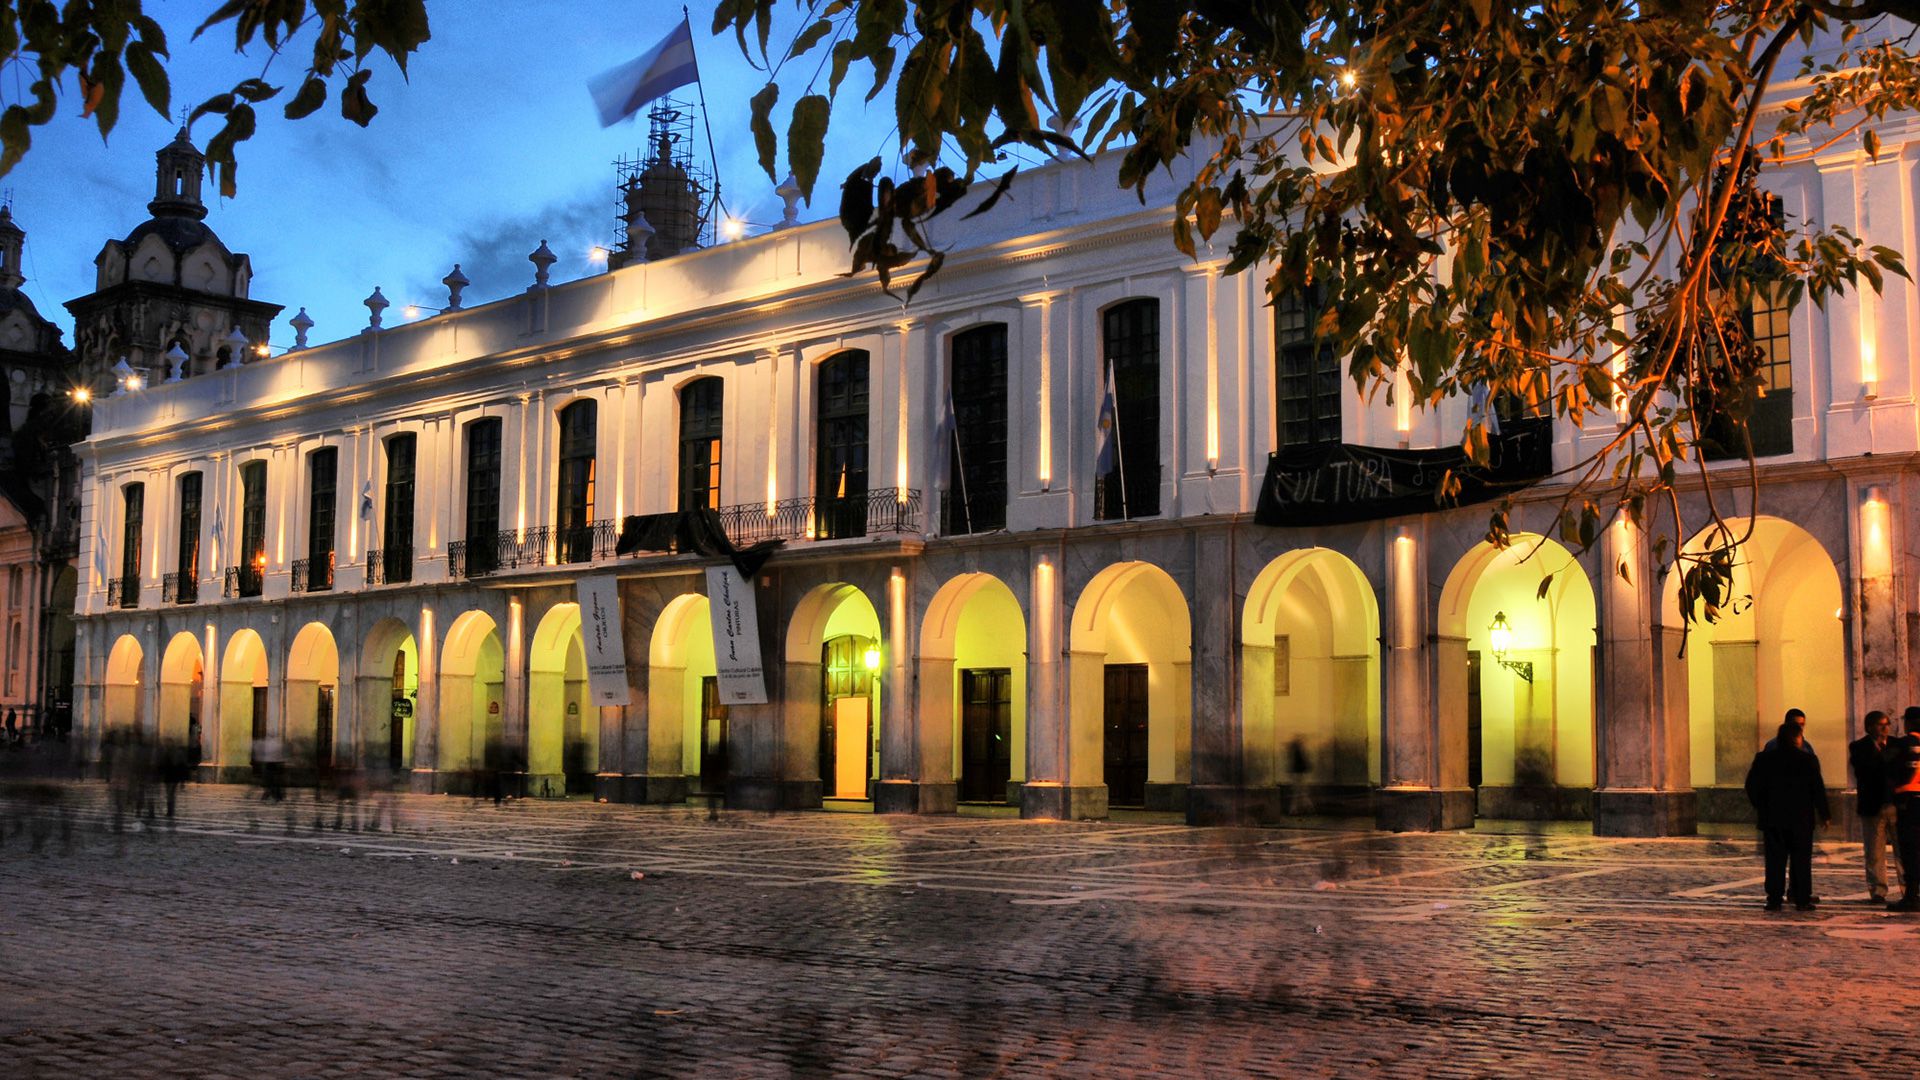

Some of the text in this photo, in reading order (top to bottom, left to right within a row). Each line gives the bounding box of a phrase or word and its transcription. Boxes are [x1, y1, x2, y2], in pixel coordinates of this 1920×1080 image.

[1274, 456, 1394, 505] CULTURA
[726, 609, 735, 638] Carlos
[733, 600, 743, 635] PINTURAS
